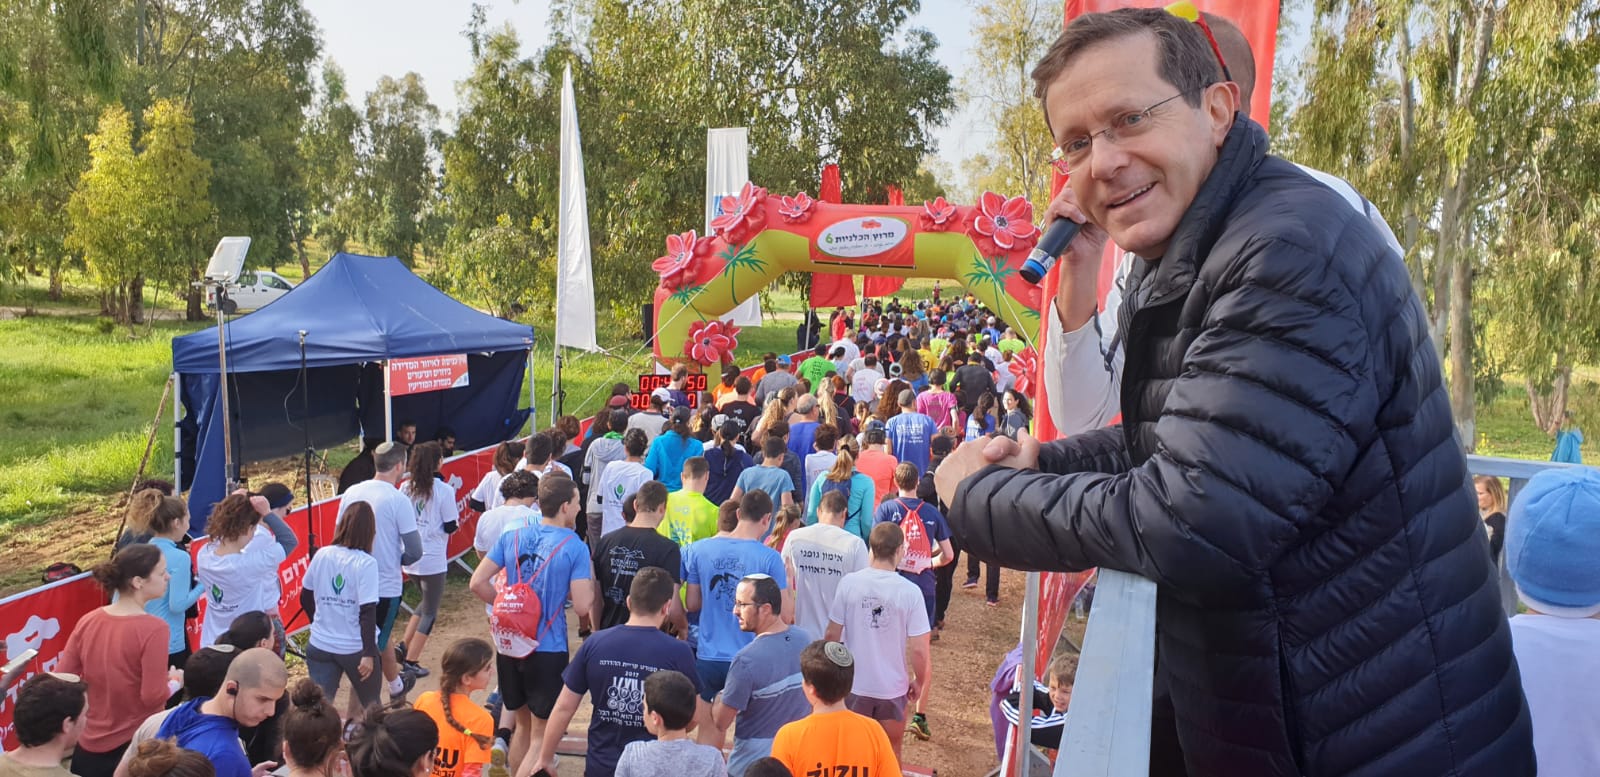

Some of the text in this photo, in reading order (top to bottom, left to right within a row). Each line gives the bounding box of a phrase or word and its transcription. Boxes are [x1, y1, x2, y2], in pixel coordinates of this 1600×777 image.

[825, 231, 894, 244] מרוץ הכלניות 6
[800, 549, 843, 562] אימון גופני
[799, 564, 842, 577] חיל האוויר
[620, 712, 633, 720] הוא
